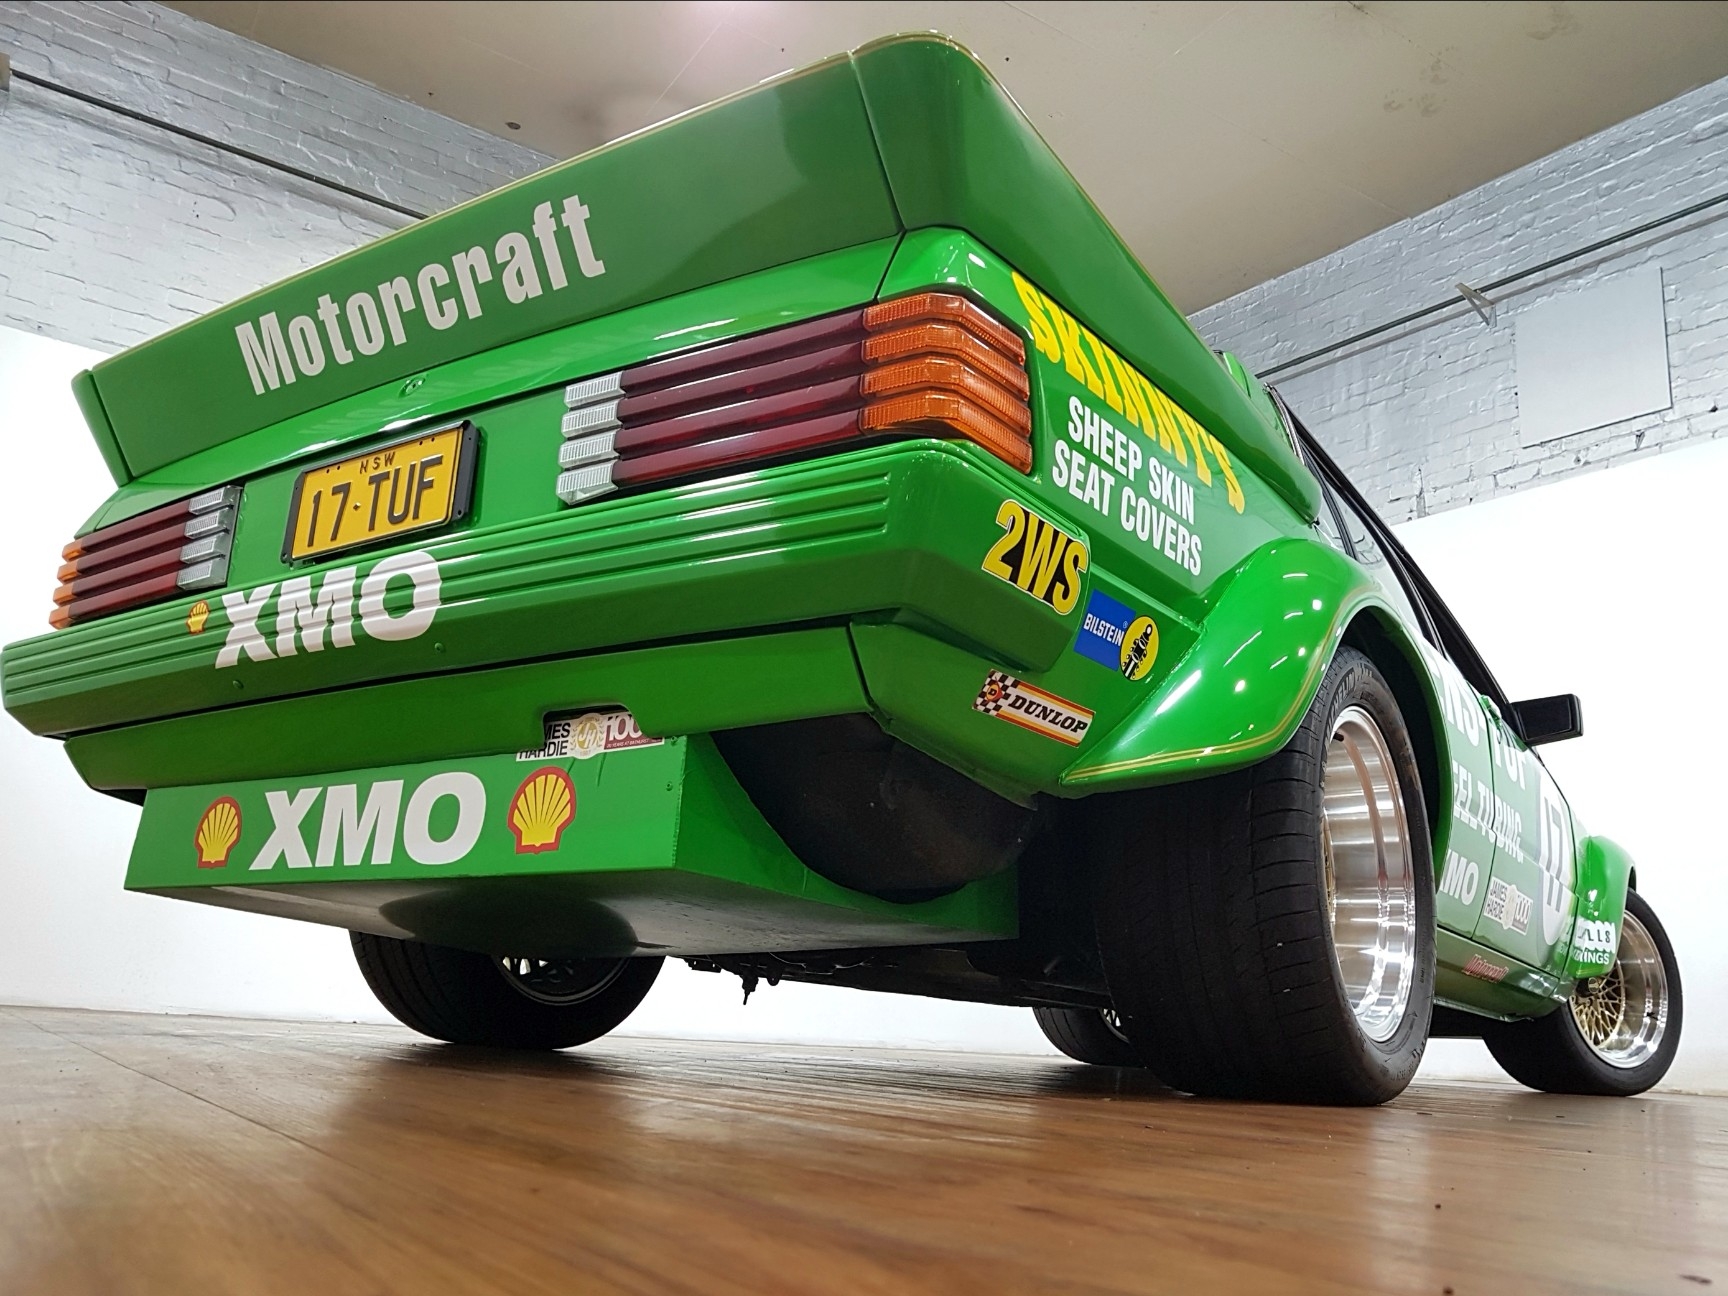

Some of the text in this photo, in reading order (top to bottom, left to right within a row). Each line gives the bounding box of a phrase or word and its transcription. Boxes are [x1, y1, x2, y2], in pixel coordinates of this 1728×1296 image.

[234, 195, 605, 395] Motorcraft
[1011, 270, 1245, 514] SKINNY'S
[360, 452, 395, 474] NSW
[1052, 440, 1202, 576] SEAT COVERS
[1068, 396, 1194, 525] SHEEP SKIN
[215, 550, 442, 669] XMO
[982, 499, 1088, 615] 2WS
[1083, 613, 1125, 646] BILSTEIN
[1008, 692, 1088, 733] DUNLOP
[249, 772, 486, 871] XMO
[1477, 780, 1523, 864] TUBING
